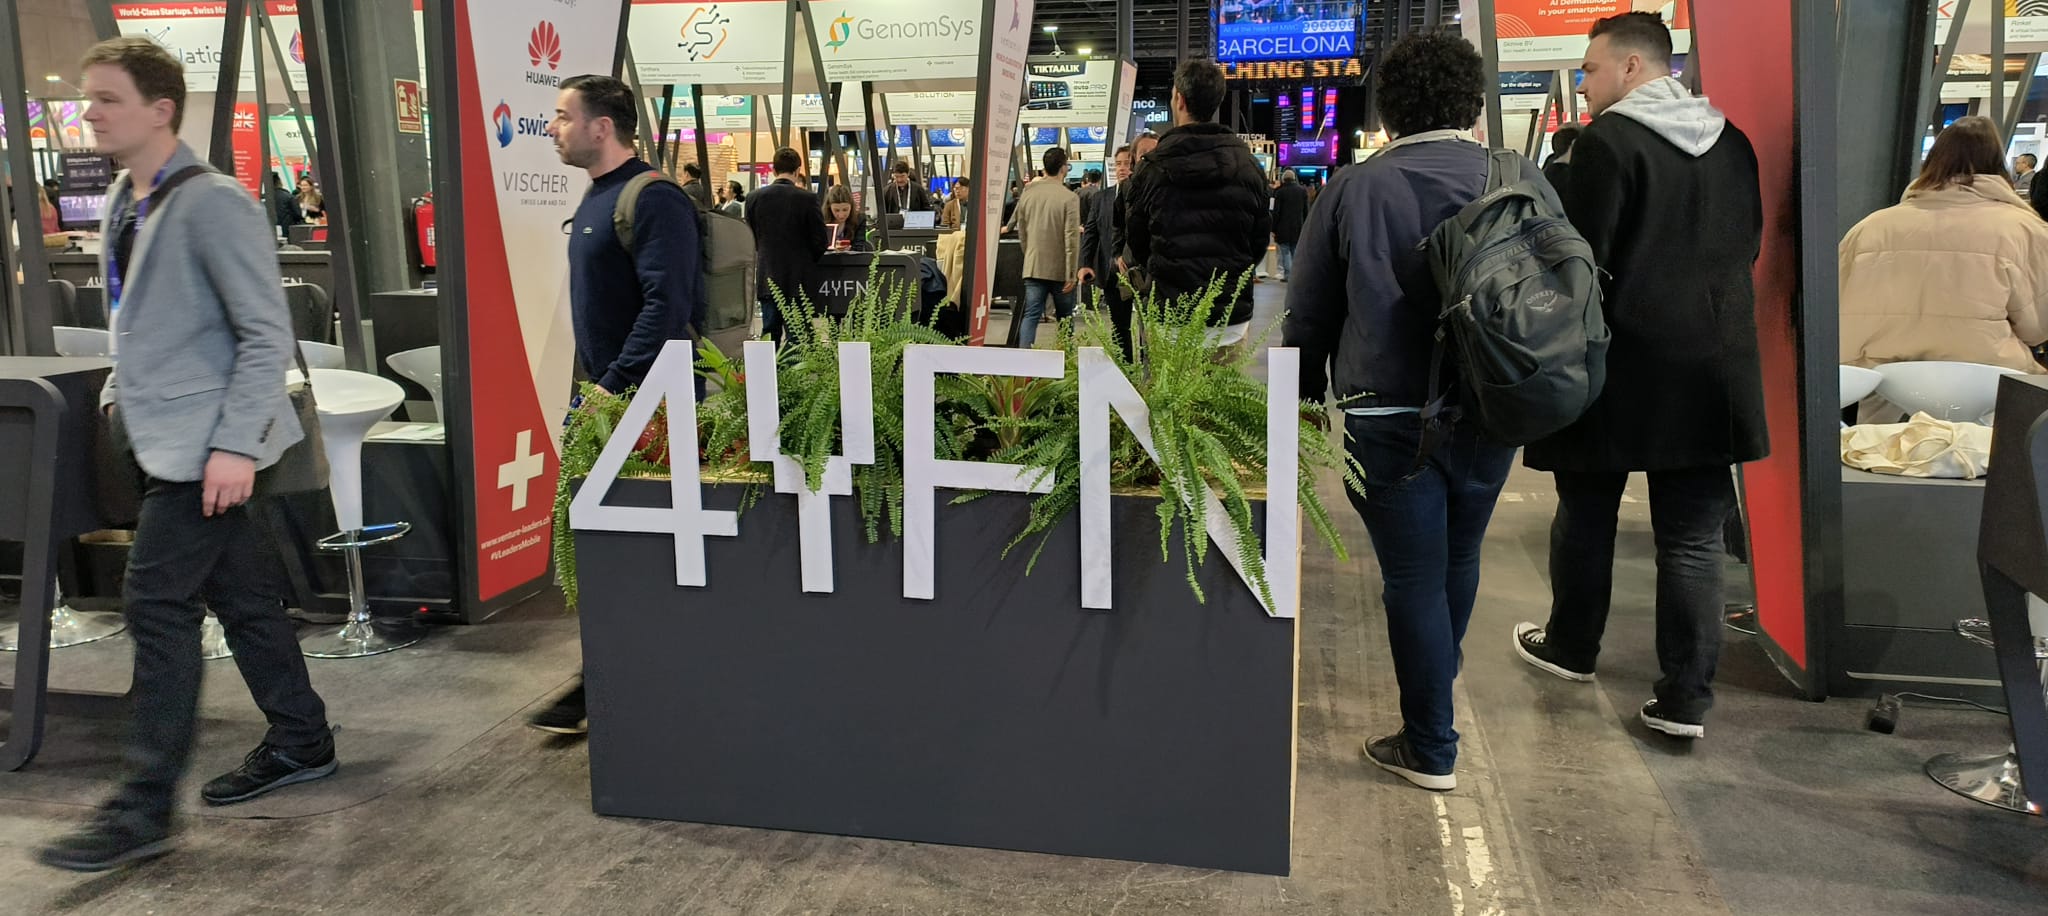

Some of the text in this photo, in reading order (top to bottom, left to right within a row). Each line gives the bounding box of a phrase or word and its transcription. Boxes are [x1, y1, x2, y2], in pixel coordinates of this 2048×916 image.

[119, 8, 160, 17] World-Class
[160, 7, 192, 16] Startups.
[193, 6, 214, 15] Swiss
[1547, 7, 1566, 17] your
[1567, 5, 1617, 14] smartphone
[856, 15, 974, 41] GenomSys
[1219, 35, 1351, 57] BARCELONA
[1033, 64, 1080, 73] TIKTAALIK
[1312, 59, 1361, 77] STA
[526, 71, 561, 88] HUAWEI
[1145, 111, 1168, 122] dell
[517, 113, 556, 138] swis
[503, 171, 569, 193] VISCHER
[818, 280, 870, 297] 4YFN
[1525, 289, 1556, 304] OSPREY
[569, 339, 1301, 618] 4YFN
